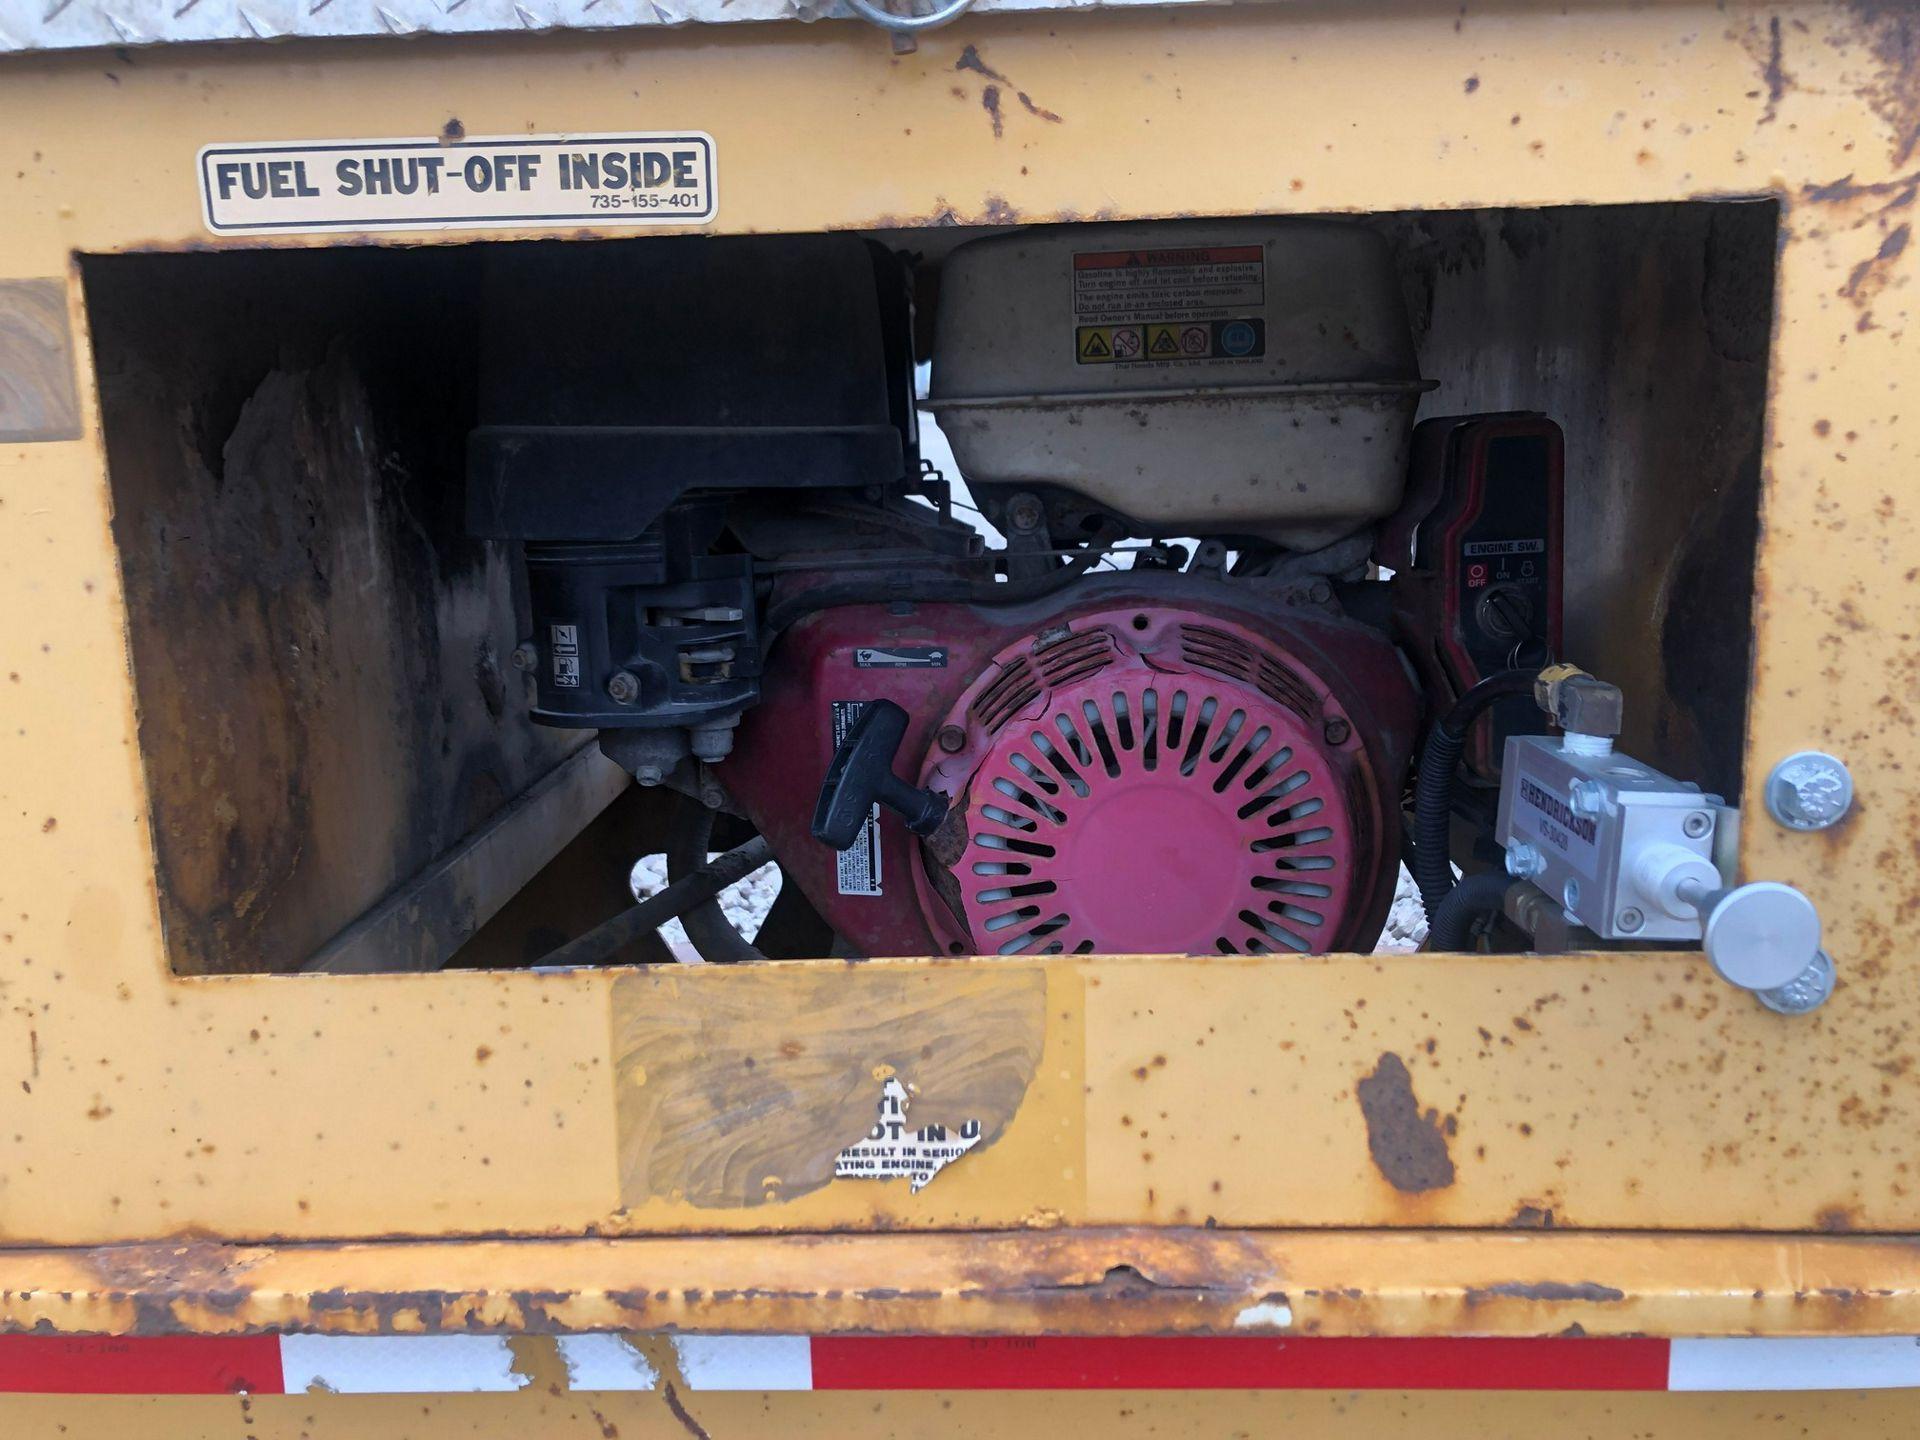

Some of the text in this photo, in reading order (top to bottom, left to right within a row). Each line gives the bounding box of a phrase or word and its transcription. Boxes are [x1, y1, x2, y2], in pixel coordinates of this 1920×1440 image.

[216, 151, 698, 200] FUEL SHUT-OFF INSIDE
[590, 193, 699, 208] 735-155-401
[1147, 250, 1210, 264] WARNING
[1078, 270, 1112, 279] Gasoline
[1199, 264, 1213, 272] and
[1078, 280, 1096, 288] Turn
[1099, 280, 1126, 289] engine
[1142, 277, 1158, 285] and
[1193, 274, 1218, 283] before
[1078, 293, 1093, 301] The
[1096, 293, 1124, 302] engine
[1127, 291, 1149, 299] emits
[1151, 290, 1170, 298] toxic
[1173, 288, 1200, 297] carbon
[1078, 303, 1089, 311] Do
[1148, 299, 1183, 307] enclosed
[1078, 314, 1098, 322] Read
[1100, 313, 1131, 321] Owner's
[1133, 312, 1163, 320] Manual
[1164, 311, 1190, 319] before
[1470, 541, 1539, 554] ENGINE SW.
[1495, 571, 1511, 580] ON
[1468, 578, 1487, 588] OFF
[1528, 782, 1597, 846] HENDRICKSON
[917, 1124, 946, 1141] IN
[960, 1120, 979, 1139] U
[841, 1147, 968, 1157] RESULT IN SERIO
[835, 1159, 937, 1171] ATING ENGINE,
[912, 1172, 929, 1181] TO
